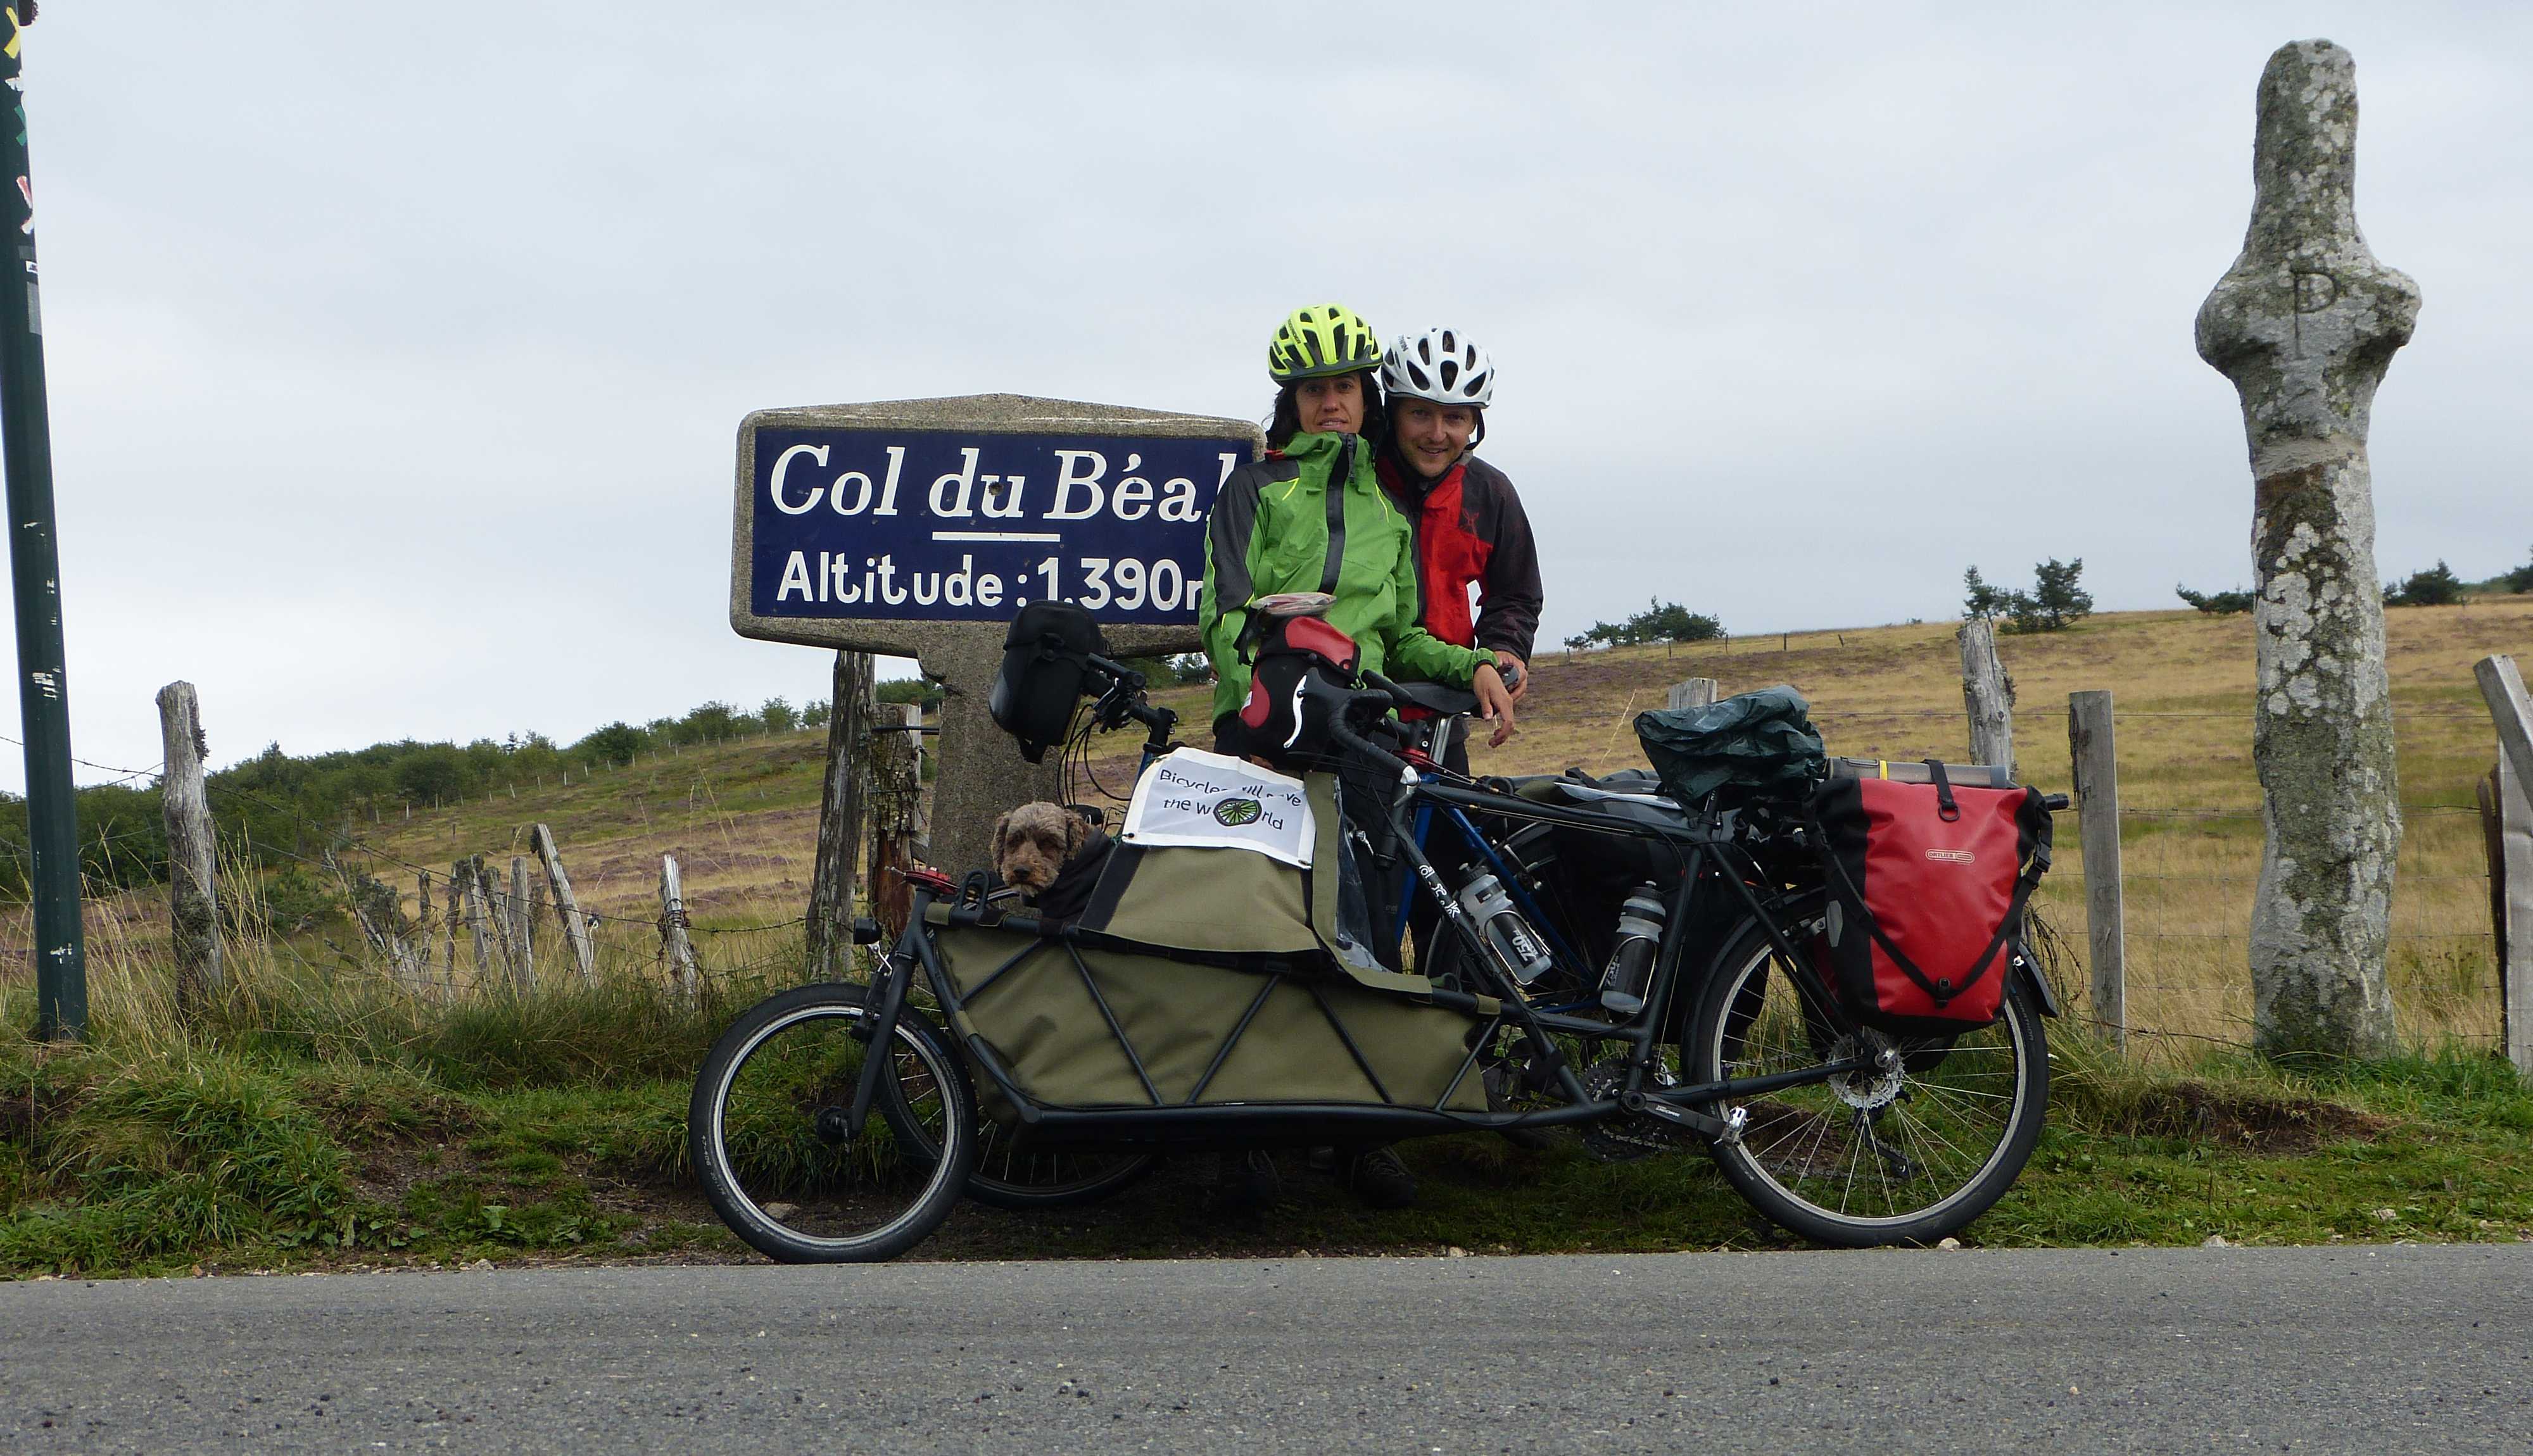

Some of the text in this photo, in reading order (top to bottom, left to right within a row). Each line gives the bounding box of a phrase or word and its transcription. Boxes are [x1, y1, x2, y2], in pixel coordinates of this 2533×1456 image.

[770, 444, 906, 516] Col
[928, 448, 1025, 518] du
[776, 551, 1003, 607] Altitude
[1163, 799, 1191, 811] the
